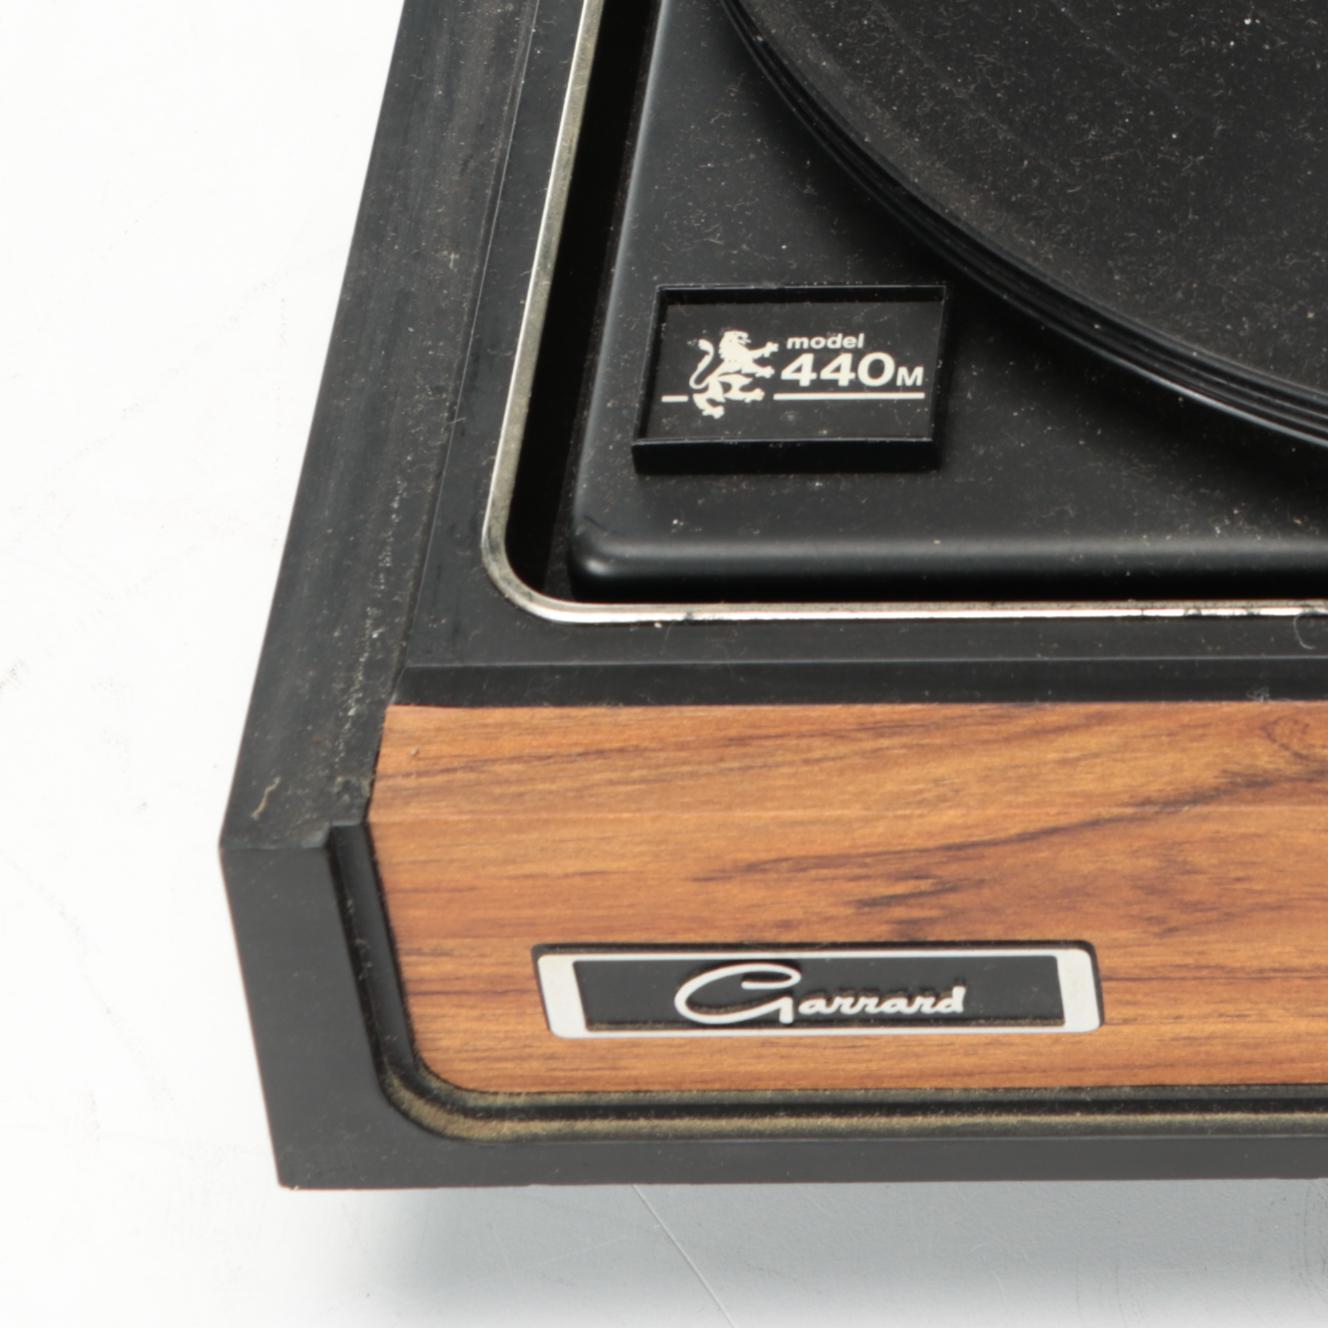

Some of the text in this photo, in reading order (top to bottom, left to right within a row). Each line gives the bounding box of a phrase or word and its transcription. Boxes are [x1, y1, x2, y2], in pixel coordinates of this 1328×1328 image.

[786, 333, 865, 350] model
[781, 352, 924, 388] 440M
[674, 962, 966, 1024] Garrard
